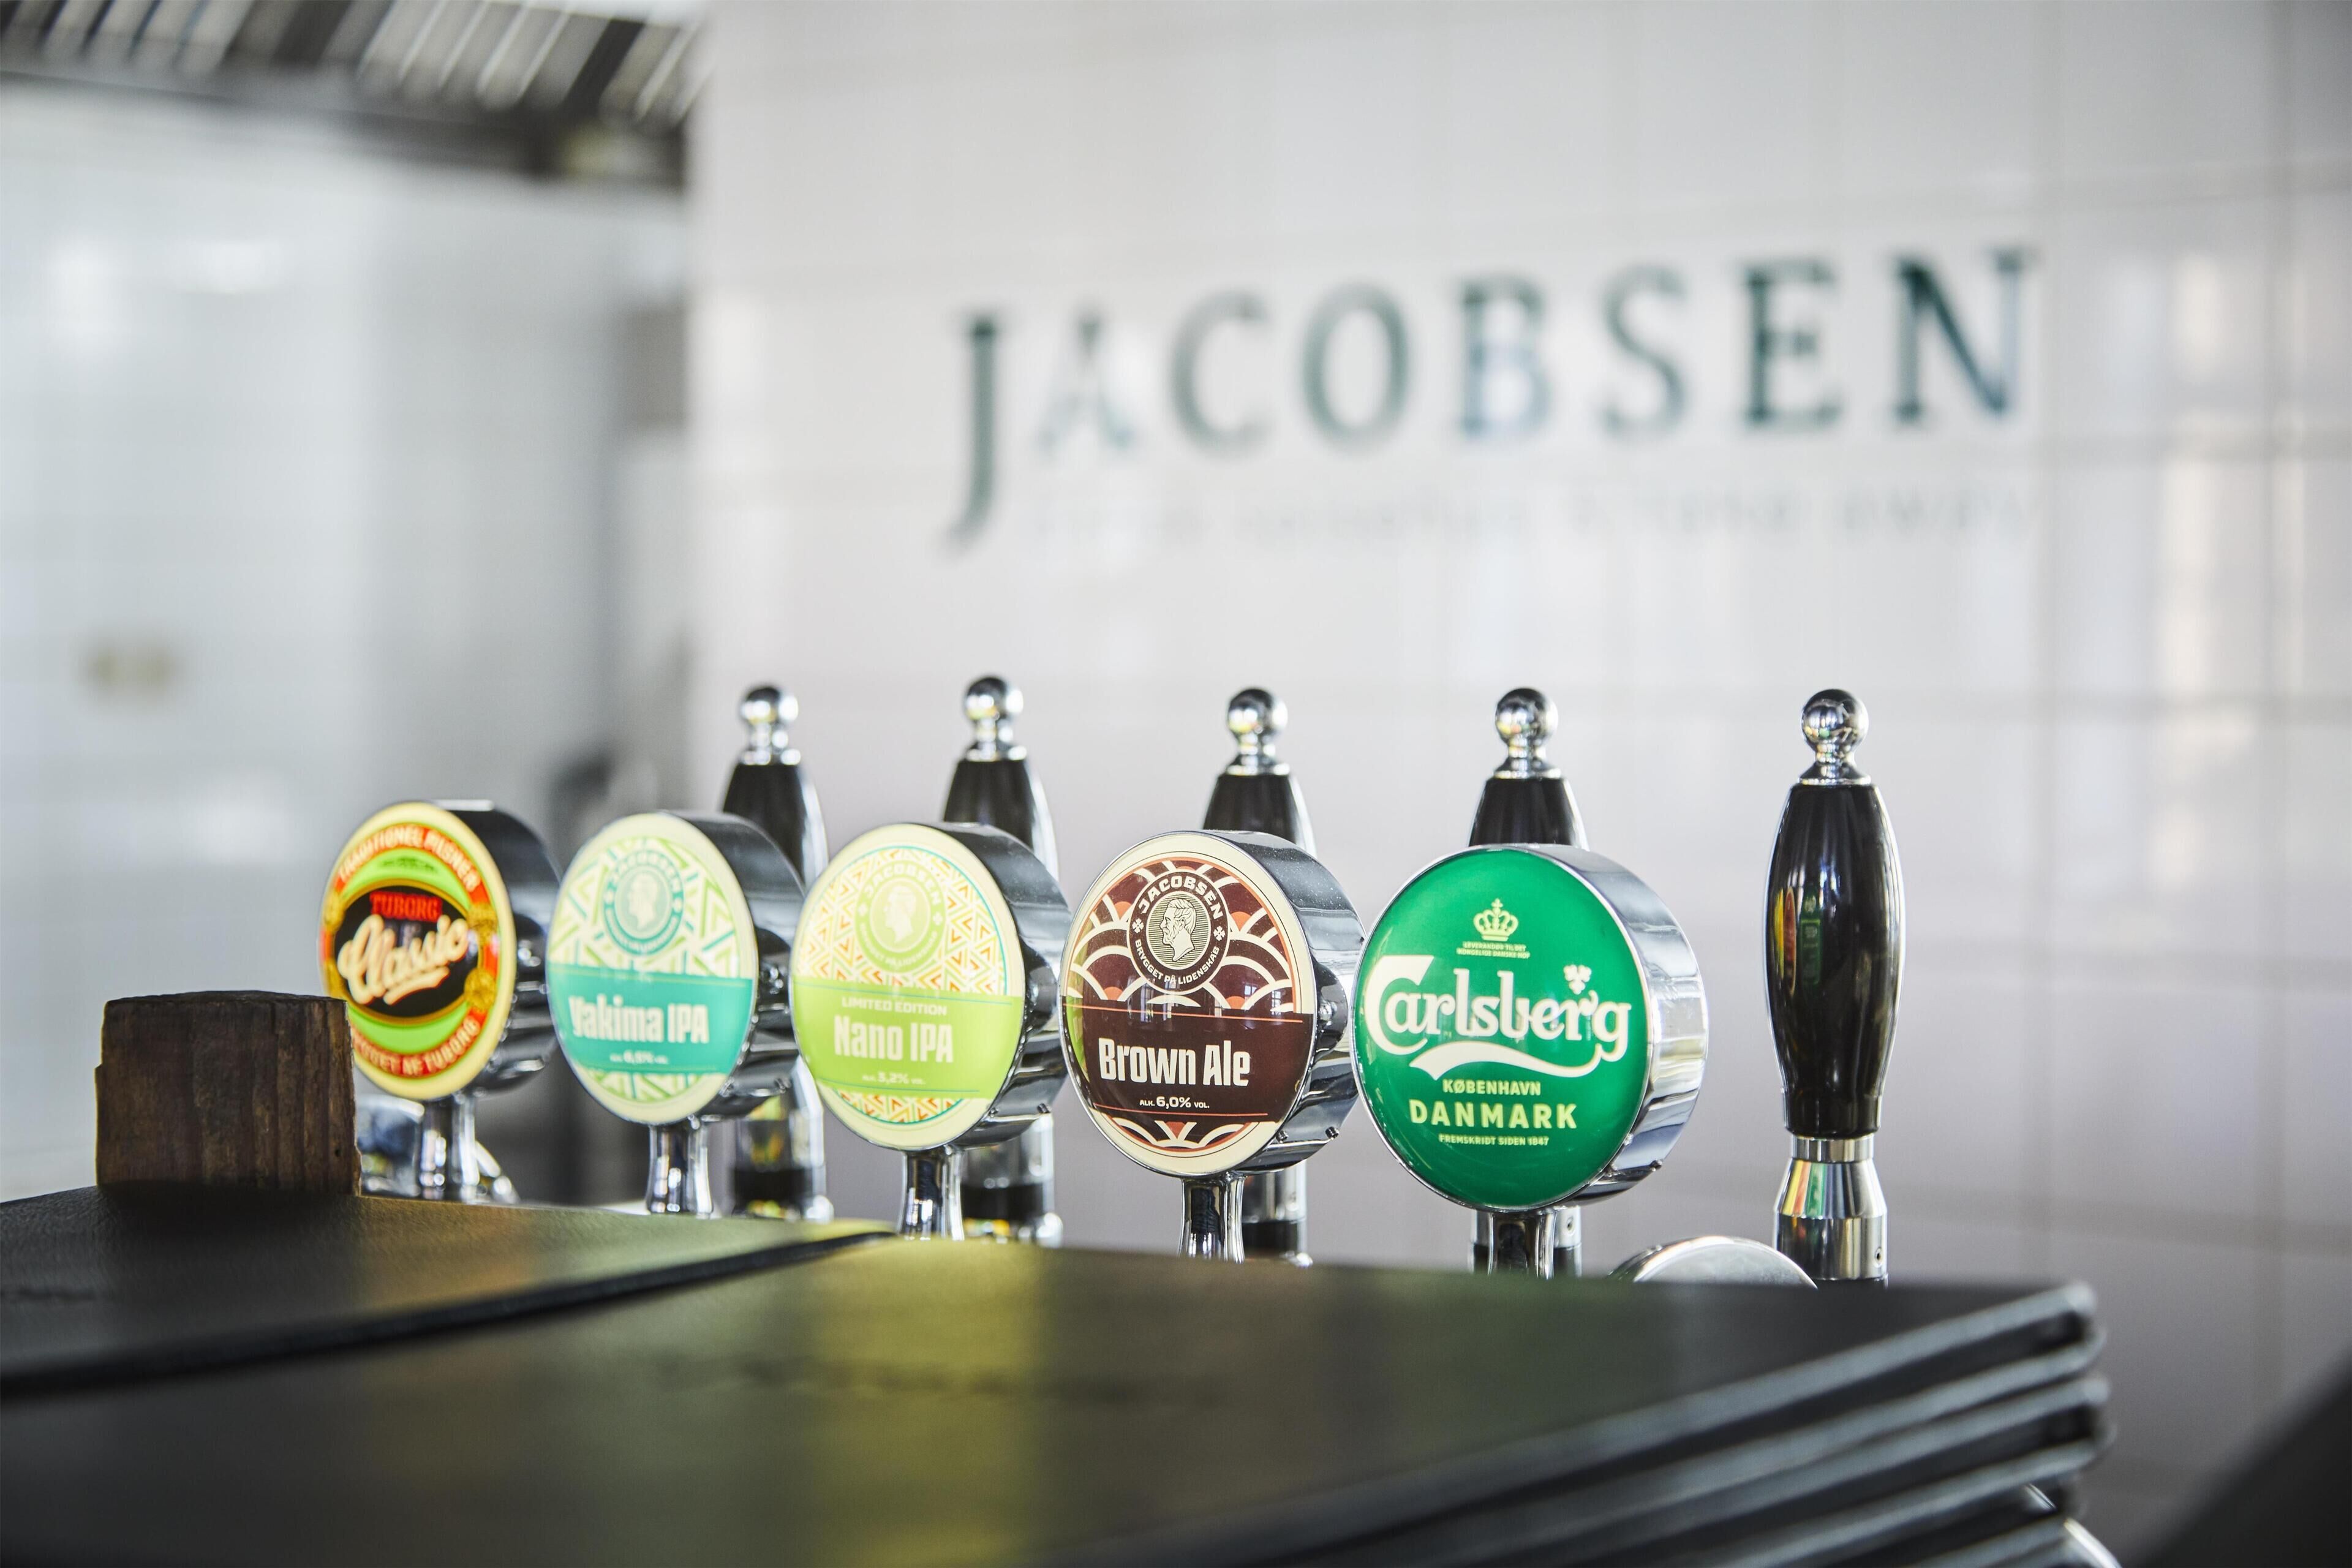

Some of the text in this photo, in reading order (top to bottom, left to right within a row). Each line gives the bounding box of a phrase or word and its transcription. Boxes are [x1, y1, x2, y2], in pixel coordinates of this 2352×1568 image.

[946, 246, 2040, 554] JACOBSEN
[370, 891, 442, 922] TUBORG
[1139, 875, 1223, 919] JACOBSEN
[337, 914, 469, 1005] Classic
[1135, 939, 1219, 985] BRYGGET PÅ LIDENSKAB
[568, 993, 710, 1044] Yakima IPA
[841, 996, 948, 1016] LIMITED EDITION
[1364, 955, 1632, 1080] Carlsberg
[834, 1014, 954, 1063] Nano IPA
[1098, 1038, 1251, 1087] Brown Ale
[1156, 1096, 1191, 1109] 6,0%
[1442, 1079, 1541, 1096] KØBENHAVN
[1409, 1099, 1577, 1129] DANMARK
[1439, 1133, 1550, 1146] FREMSKRIDT SIDEN 1847
